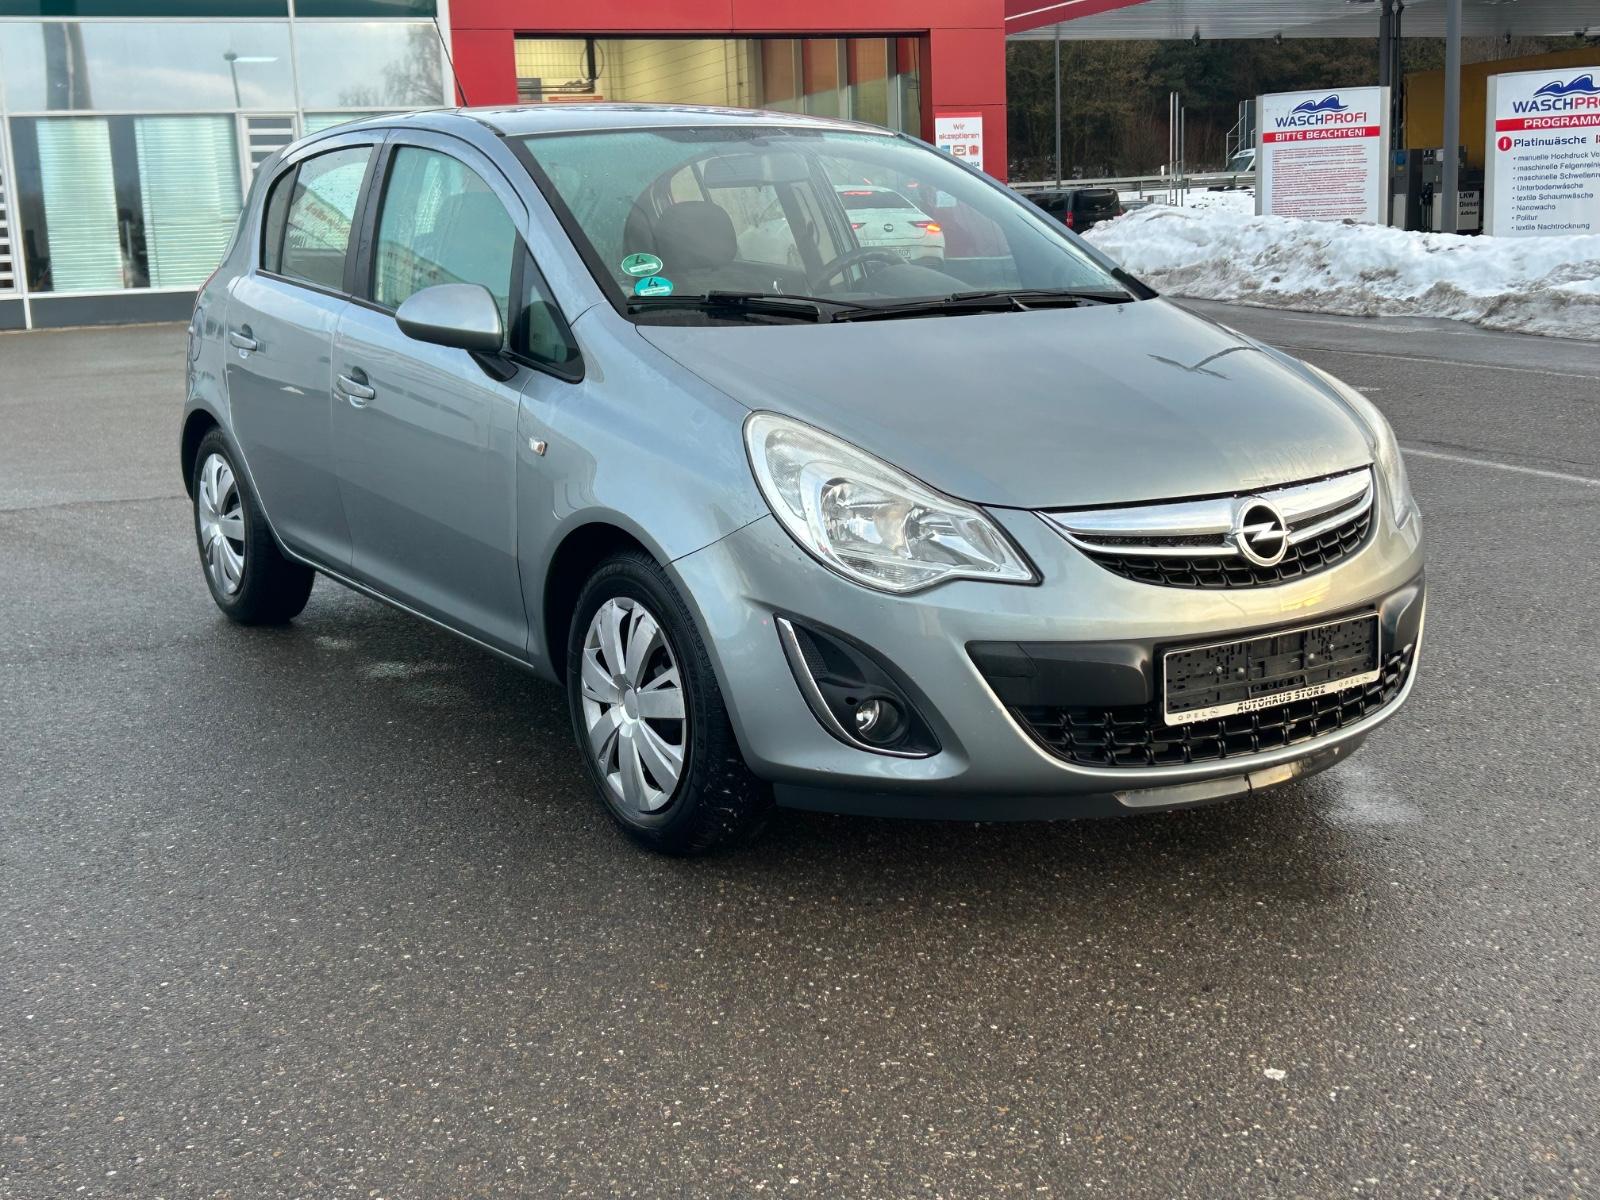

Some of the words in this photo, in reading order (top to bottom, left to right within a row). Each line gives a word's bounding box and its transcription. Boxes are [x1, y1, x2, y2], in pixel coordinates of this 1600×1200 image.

[1512, 96, 1600, 113] WASCHPR
[1275, 112, 1367, 127] WASCHPROFI
[939, 132, 980, 140] akzeptieren
[1275, 131, 1304, 141] BITTE
[1513, 136, 1587, 148] Platinwäsche
[1517, 153, 1549, 161] manuelle
[1551, 151, 1589, 160] Hochdruck
[1517, 163, 1558, 171] maschinelle
[1560, 161, 1600, 170] Felgenreini
[1517, 173, 1557, 181] maschinelle
[1516, 182, 1584, 191] Unterbodenwäsche
[1516, 193, 1537, 201] textile
[1538, 192, 1594, 201] Schaumwäsche
[1515, 223, 1536, 231] textile
[1537, 222, 1591, 230] Nachtrocknung
[1177, 711, 1207, 721] OPEL
[1237, 692, 1292, 712] AUTOHAUS
[1294, 685, 1326, 700] STORZ
